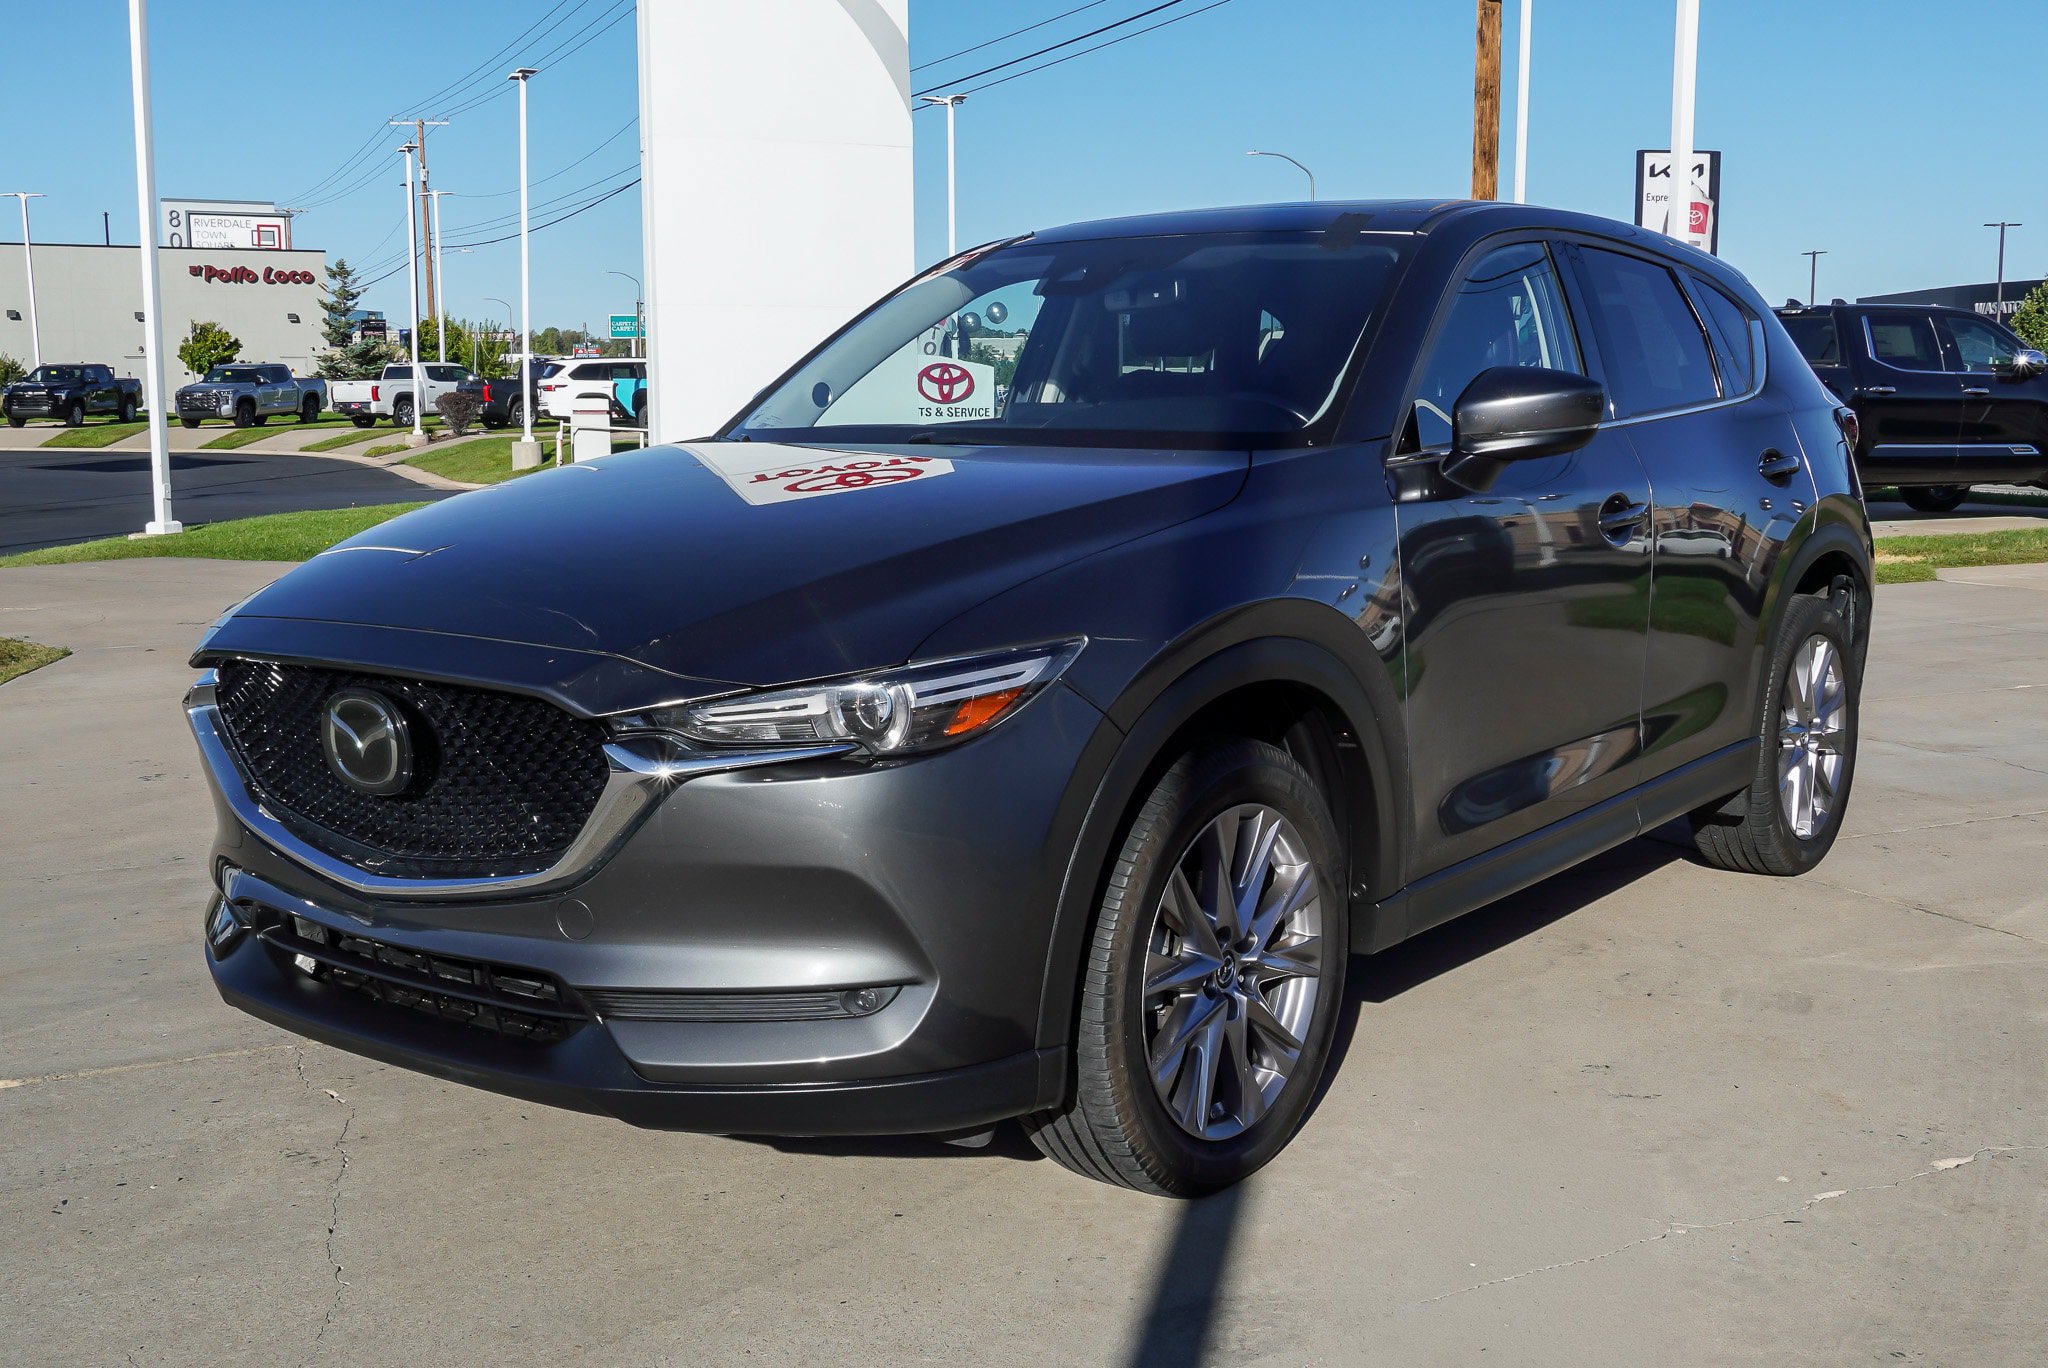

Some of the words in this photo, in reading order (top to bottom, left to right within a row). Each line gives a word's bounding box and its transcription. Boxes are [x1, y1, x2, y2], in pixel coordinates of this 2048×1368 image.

[1646, 192, 1669, 203] Expre
[193, 217, 252, 229] RIVERDALE
[195, 230, 227, 240] TOWN
[188, 265, 203, 277] El
[203, 264, 259, 284] Pollo
[262, 266, 316, 285] Loco
[1974, 300, 2024, 315] WASATC
[918, 407, 932, 417] TS
[935, 407, 944, 417] &
[946, 406, 991, 418] SERVICE
